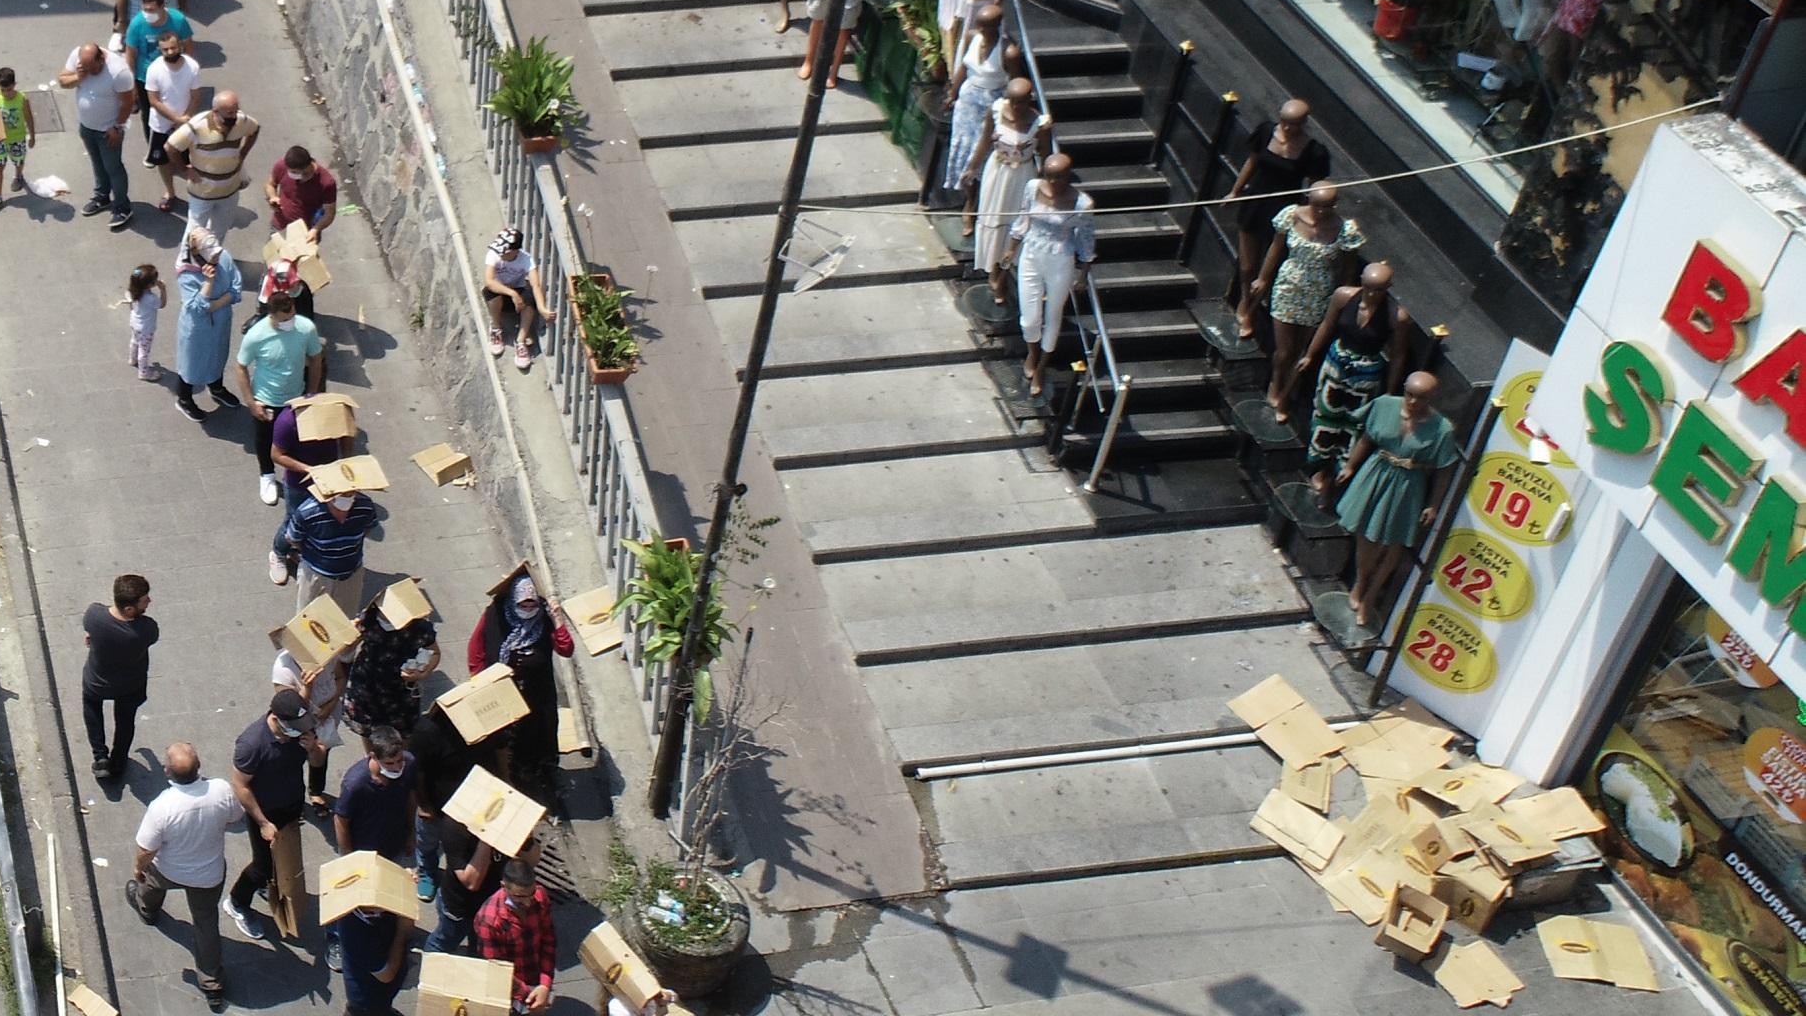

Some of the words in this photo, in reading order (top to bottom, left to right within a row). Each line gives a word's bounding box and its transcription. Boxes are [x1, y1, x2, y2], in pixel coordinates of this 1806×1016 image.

[1497, 468, 1553, 504] BAKLAVA
[1505, 461, 1555, 492] CEVİZLİ
[1483, 480, 1532, 530] 19
[1475, 541, 1514, 569] FISTIK
[1441, 553, 1494, 606] 42
[1406, 629, 1457, 673] 28
[1426, 618, 1480, 658] BAKLAVA
